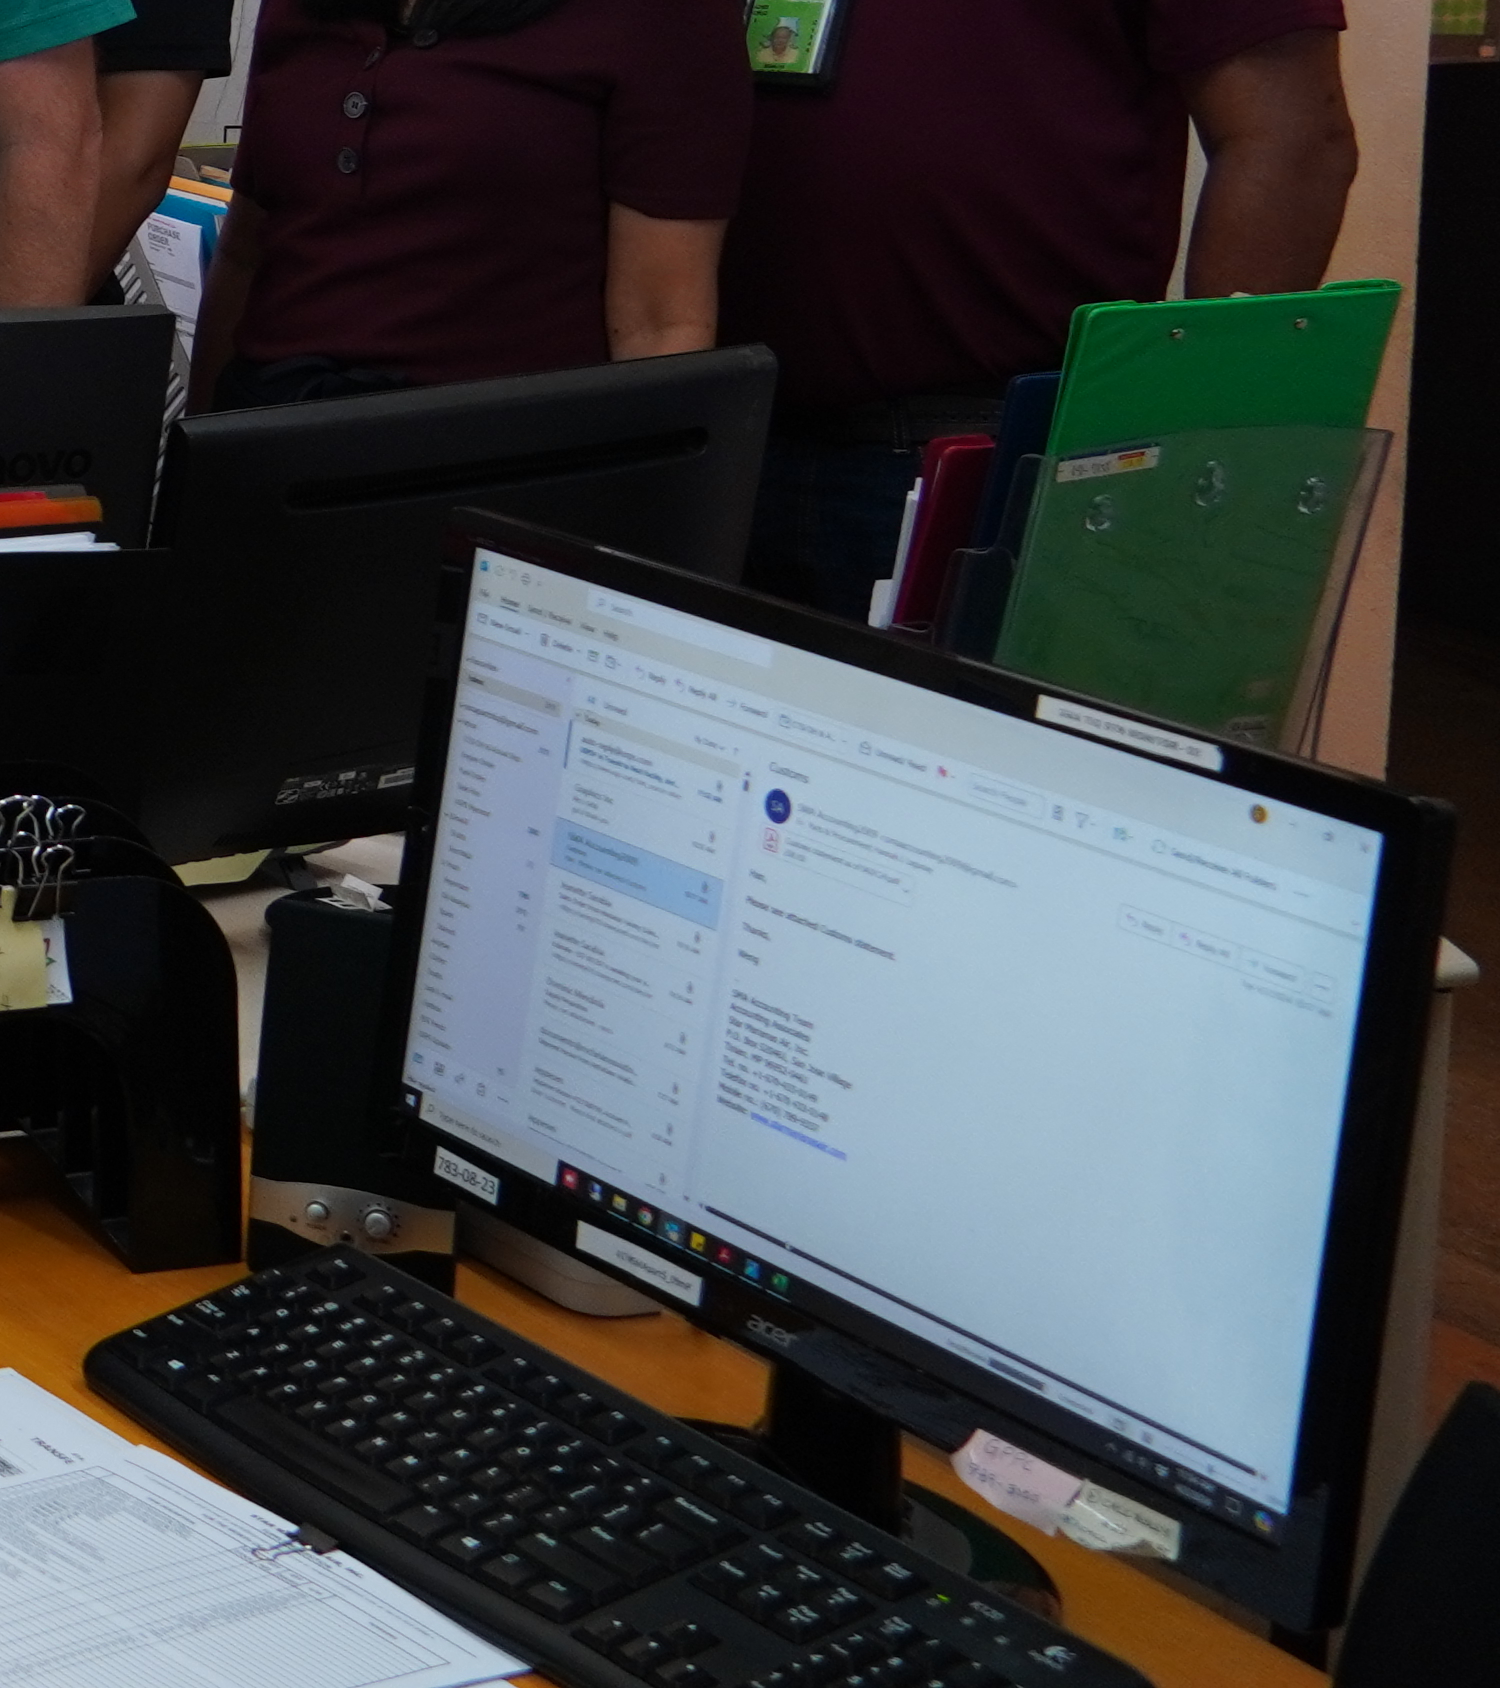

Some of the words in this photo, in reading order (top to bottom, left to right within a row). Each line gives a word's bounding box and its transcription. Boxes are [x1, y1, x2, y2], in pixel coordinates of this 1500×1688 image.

[769, 761, 809, 784] Customs
[437, 1156, 496, 1196] 783-08-23
[746, 1313, 800, 1348] acer
